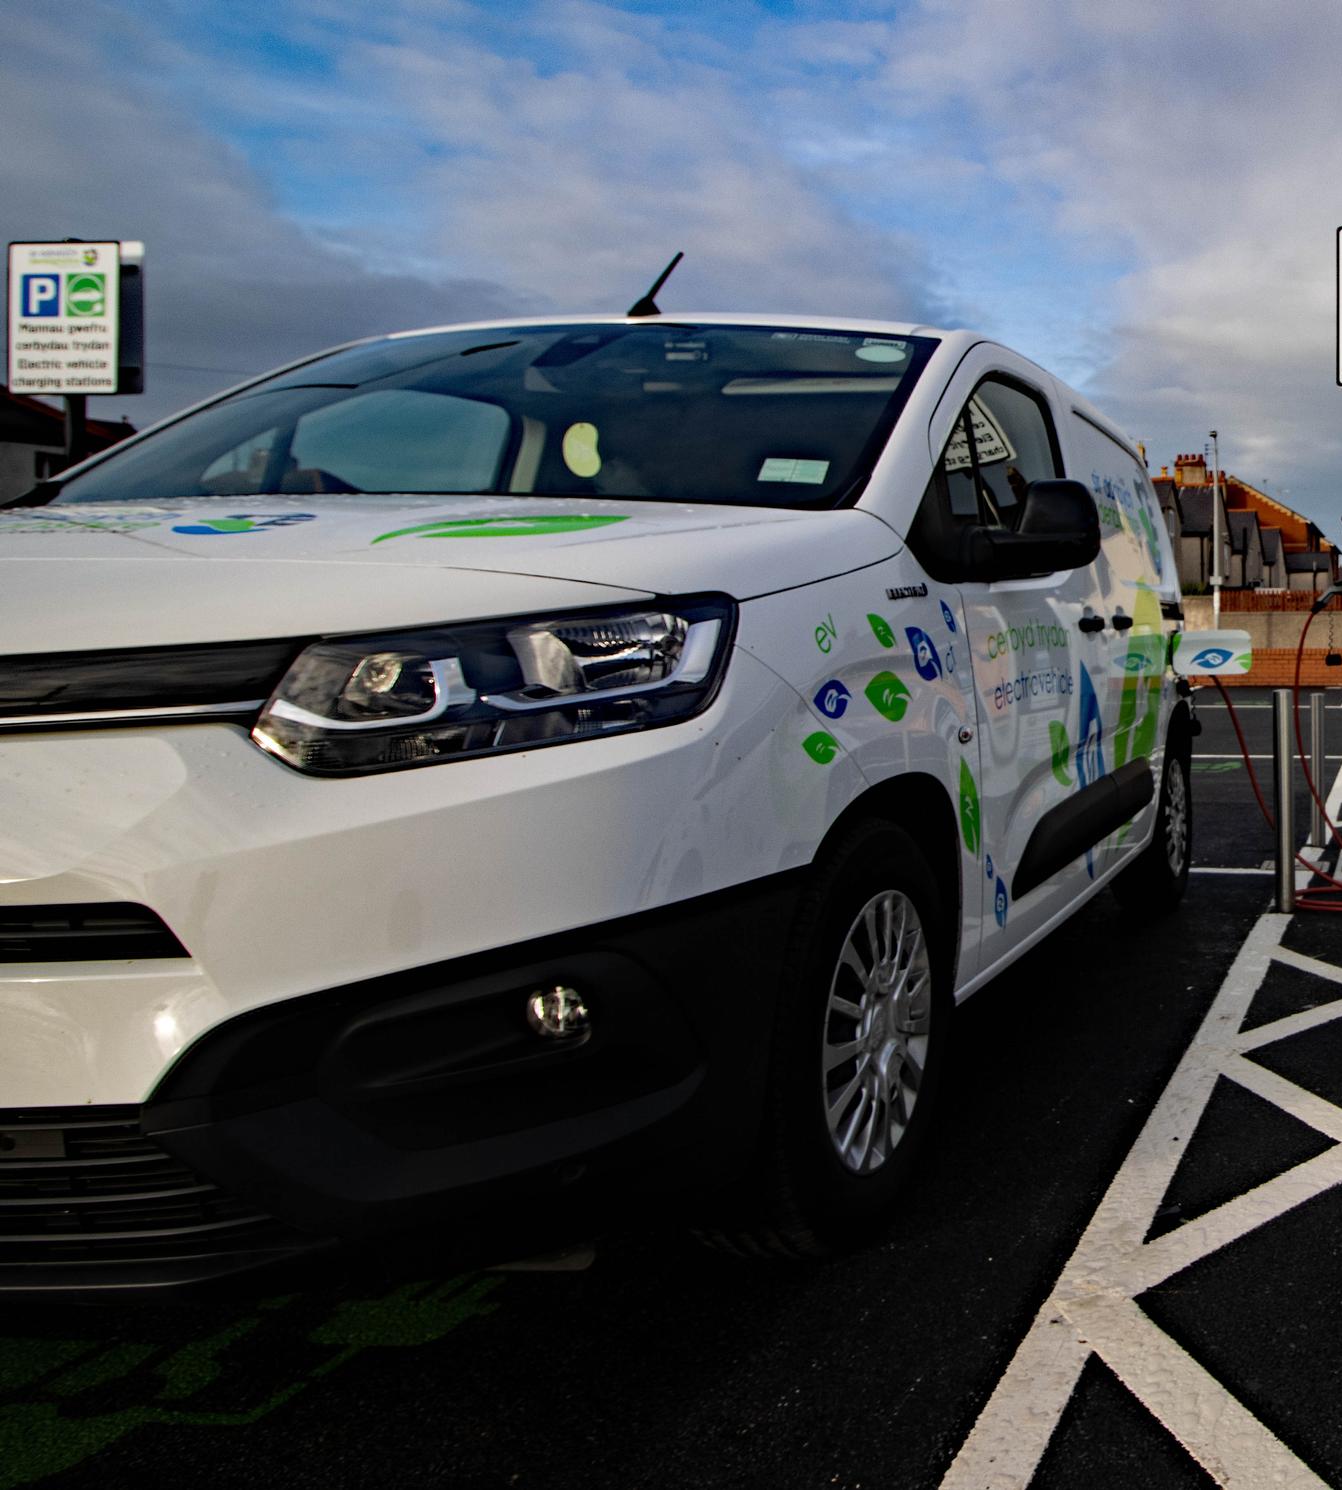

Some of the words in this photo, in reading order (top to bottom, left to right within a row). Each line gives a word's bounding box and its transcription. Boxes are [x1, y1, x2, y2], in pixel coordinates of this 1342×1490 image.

[28, 277, 57, 314] P
[815, 612, 838, 654] ev
[994, 669, 1038, 710] electric
